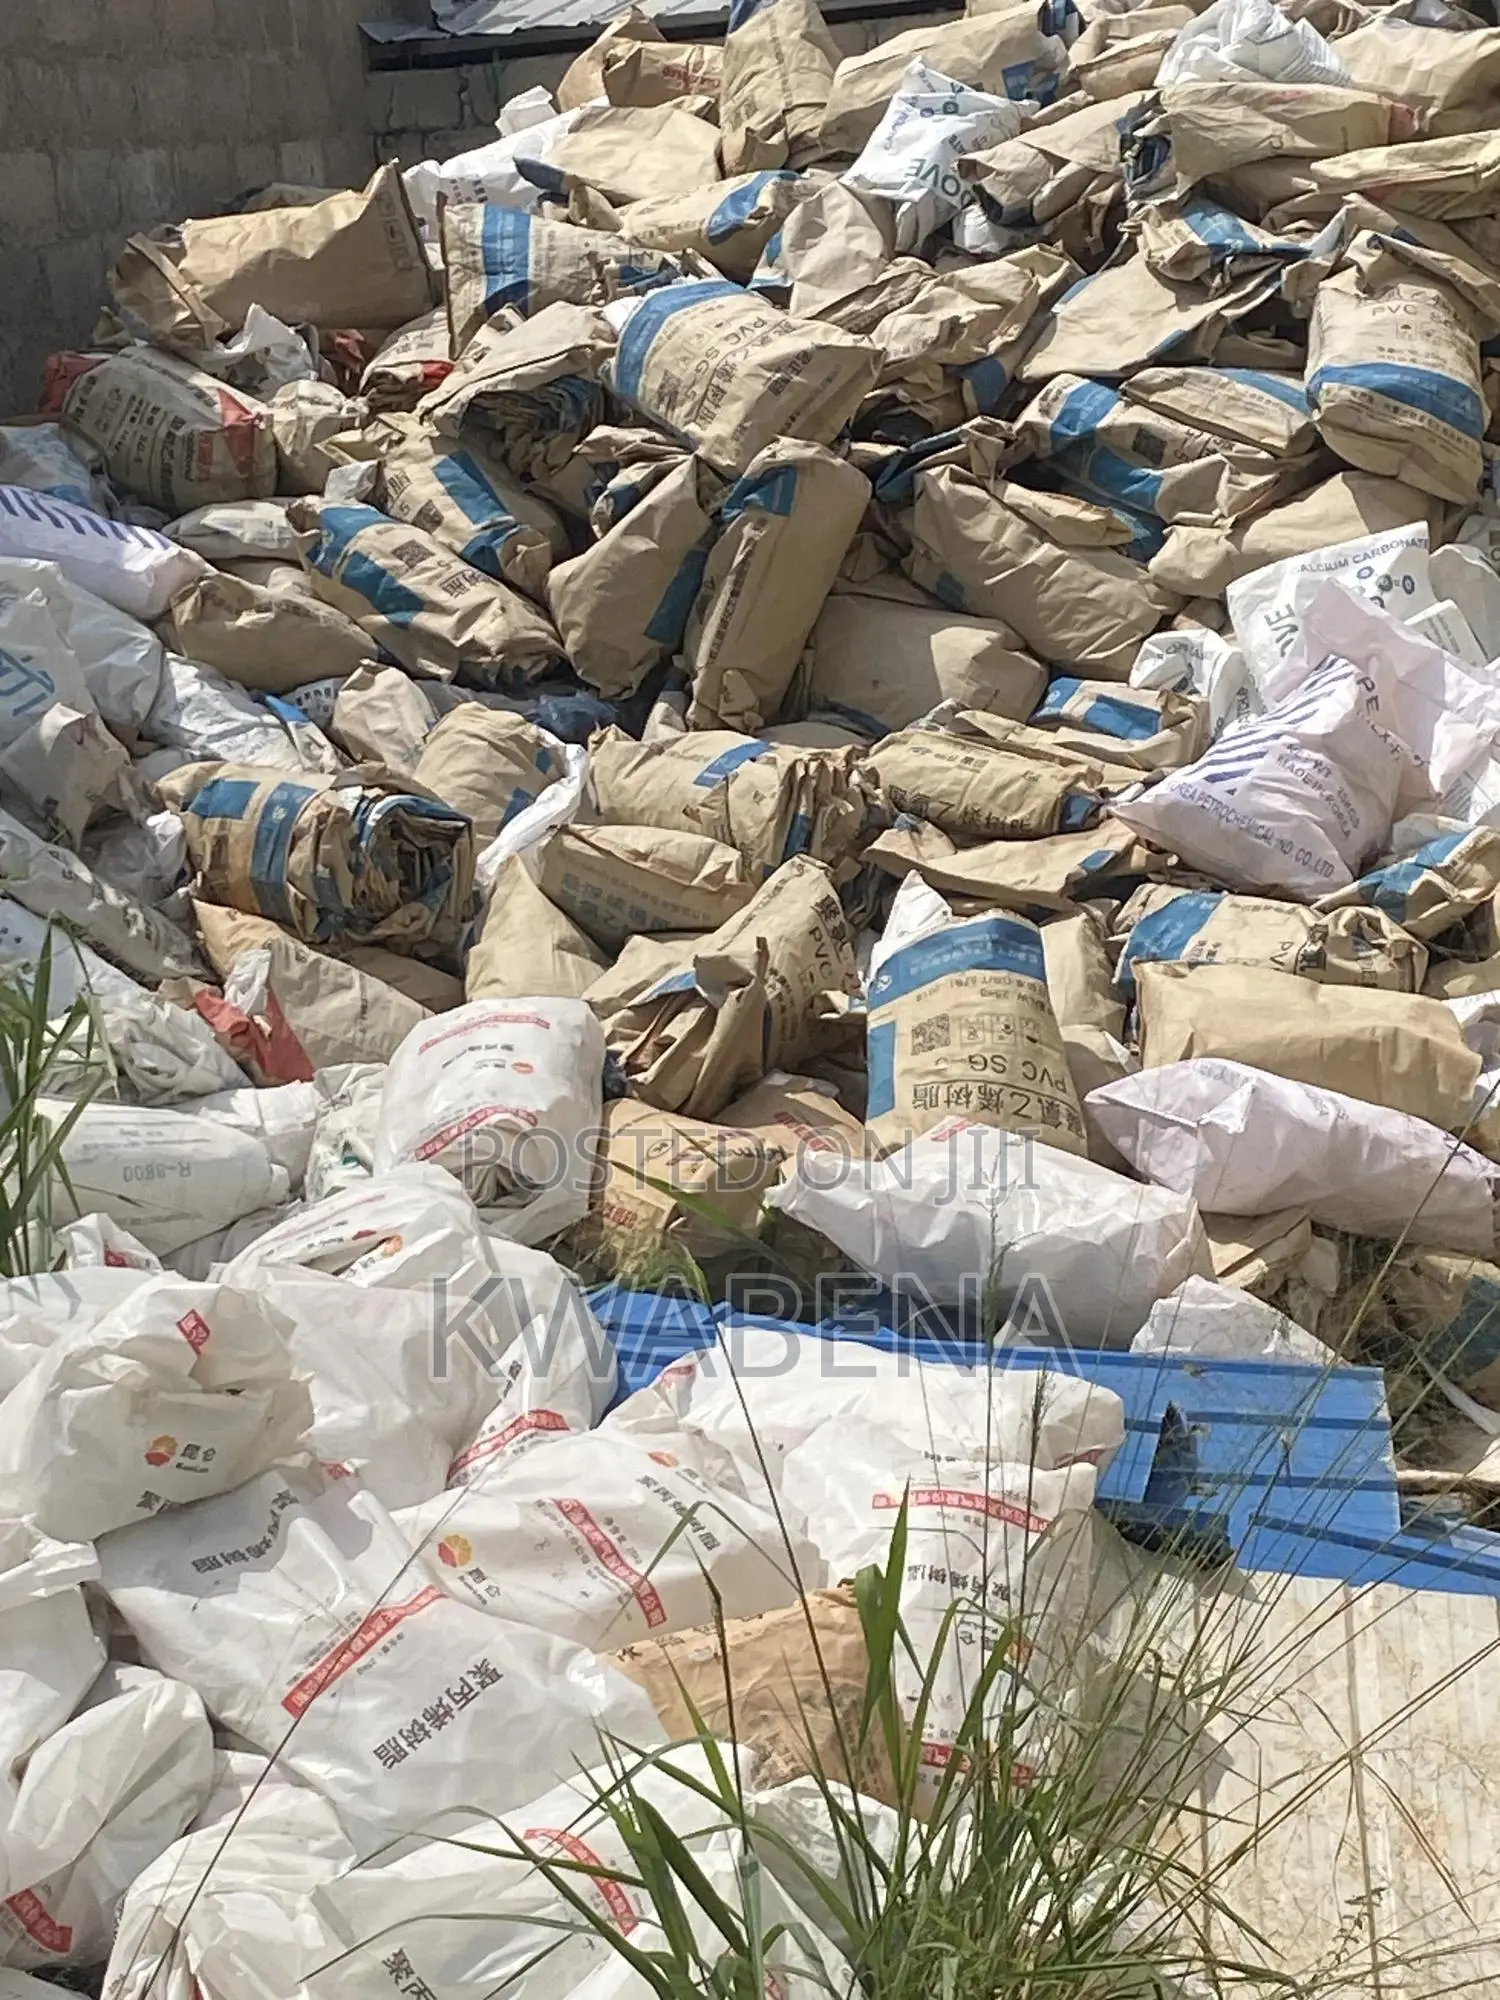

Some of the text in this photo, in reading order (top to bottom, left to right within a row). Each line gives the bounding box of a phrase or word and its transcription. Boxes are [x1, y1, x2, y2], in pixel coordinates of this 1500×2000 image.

[1372, 303, 1419, 317] PVC
[1020, 1060, 1068, 1094] PVC
[372, 1657, 504, 1770] 聚丙烯树脂
